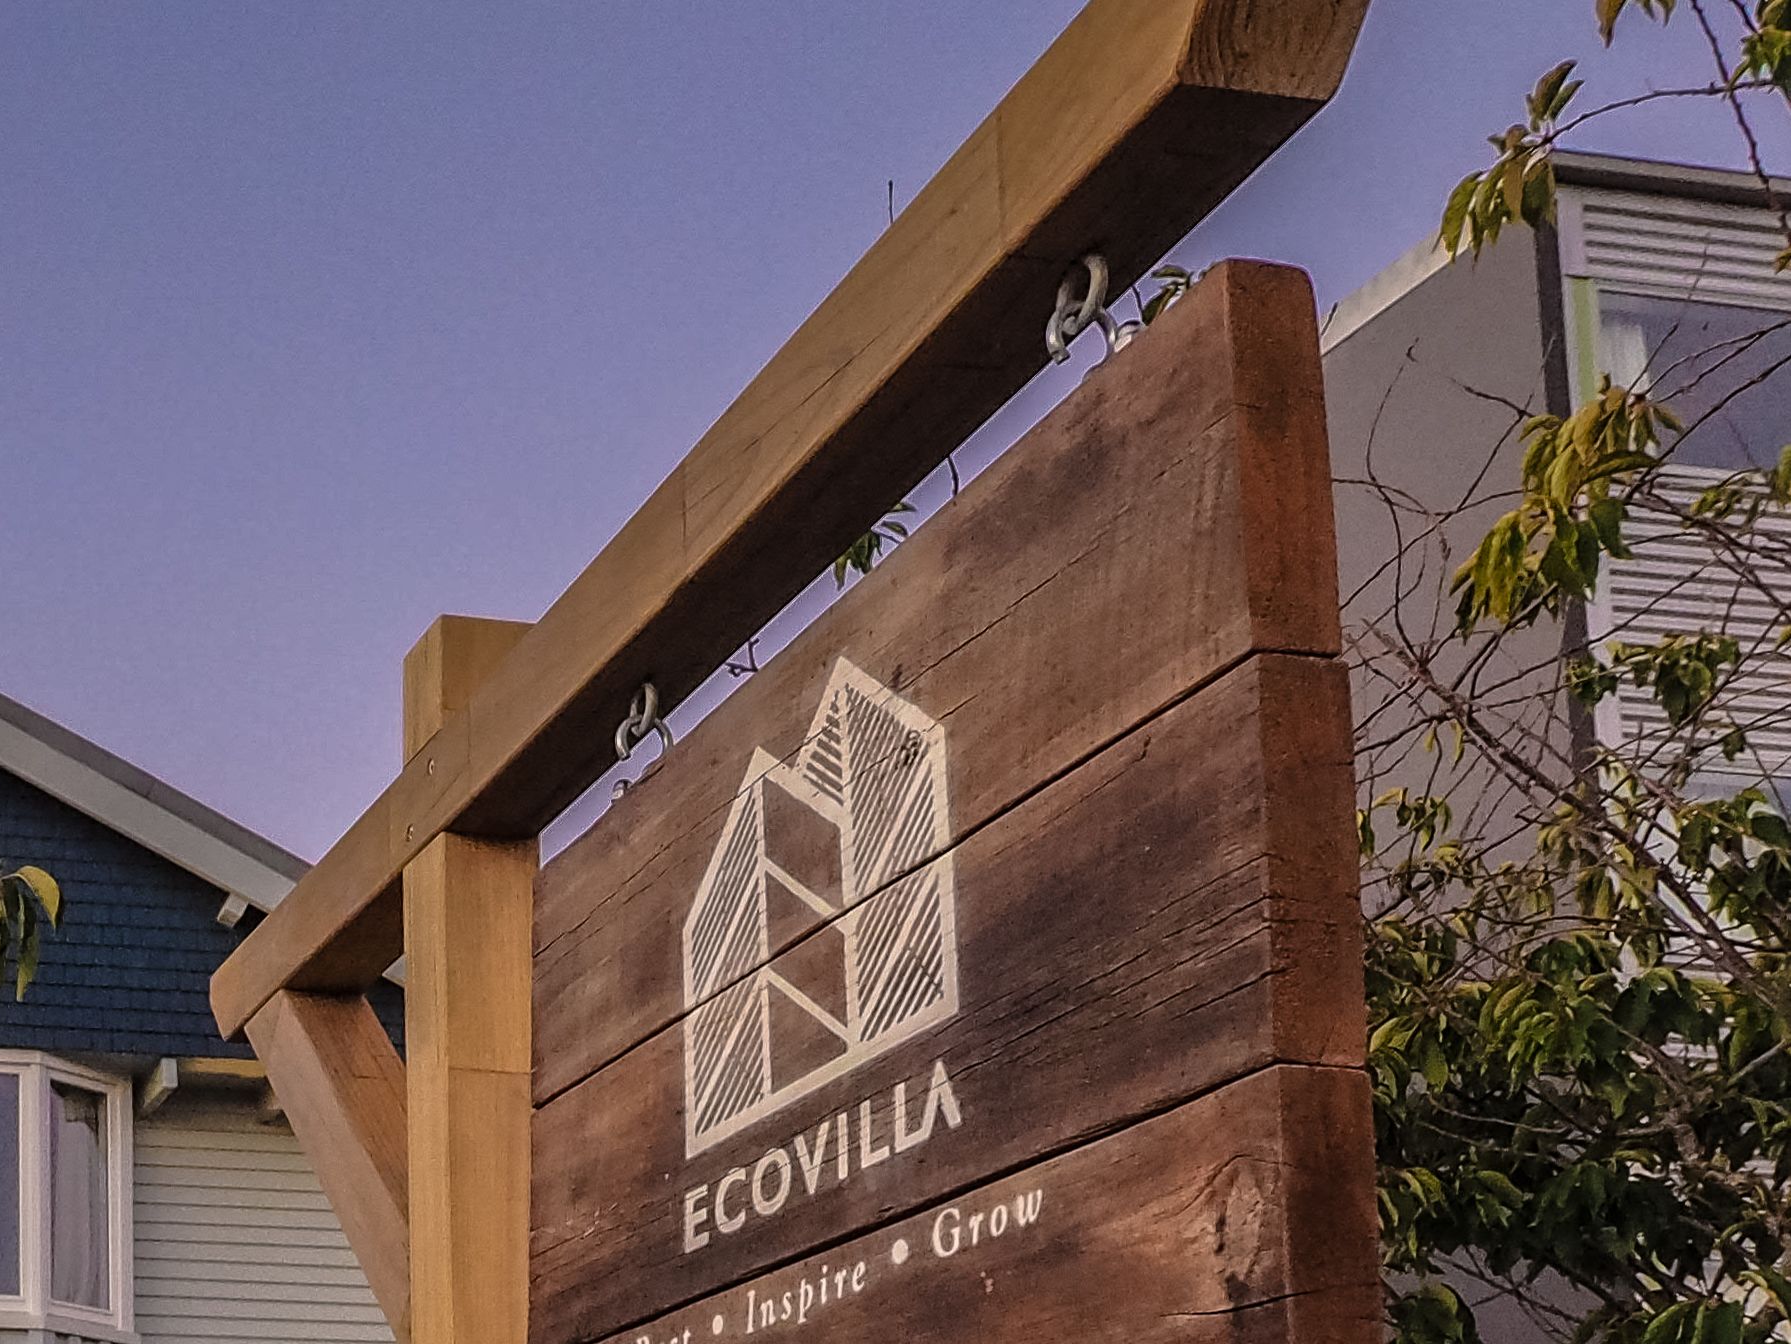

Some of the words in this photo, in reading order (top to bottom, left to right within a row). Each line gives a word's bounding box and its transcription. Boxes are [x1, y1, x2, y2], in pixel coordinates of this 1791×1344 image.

[683, 1059, 962, 1254] ECOVILLA
[744, 1260, 867, 1335] Inspire
[931, 1187, 1044, 1258] Grow
